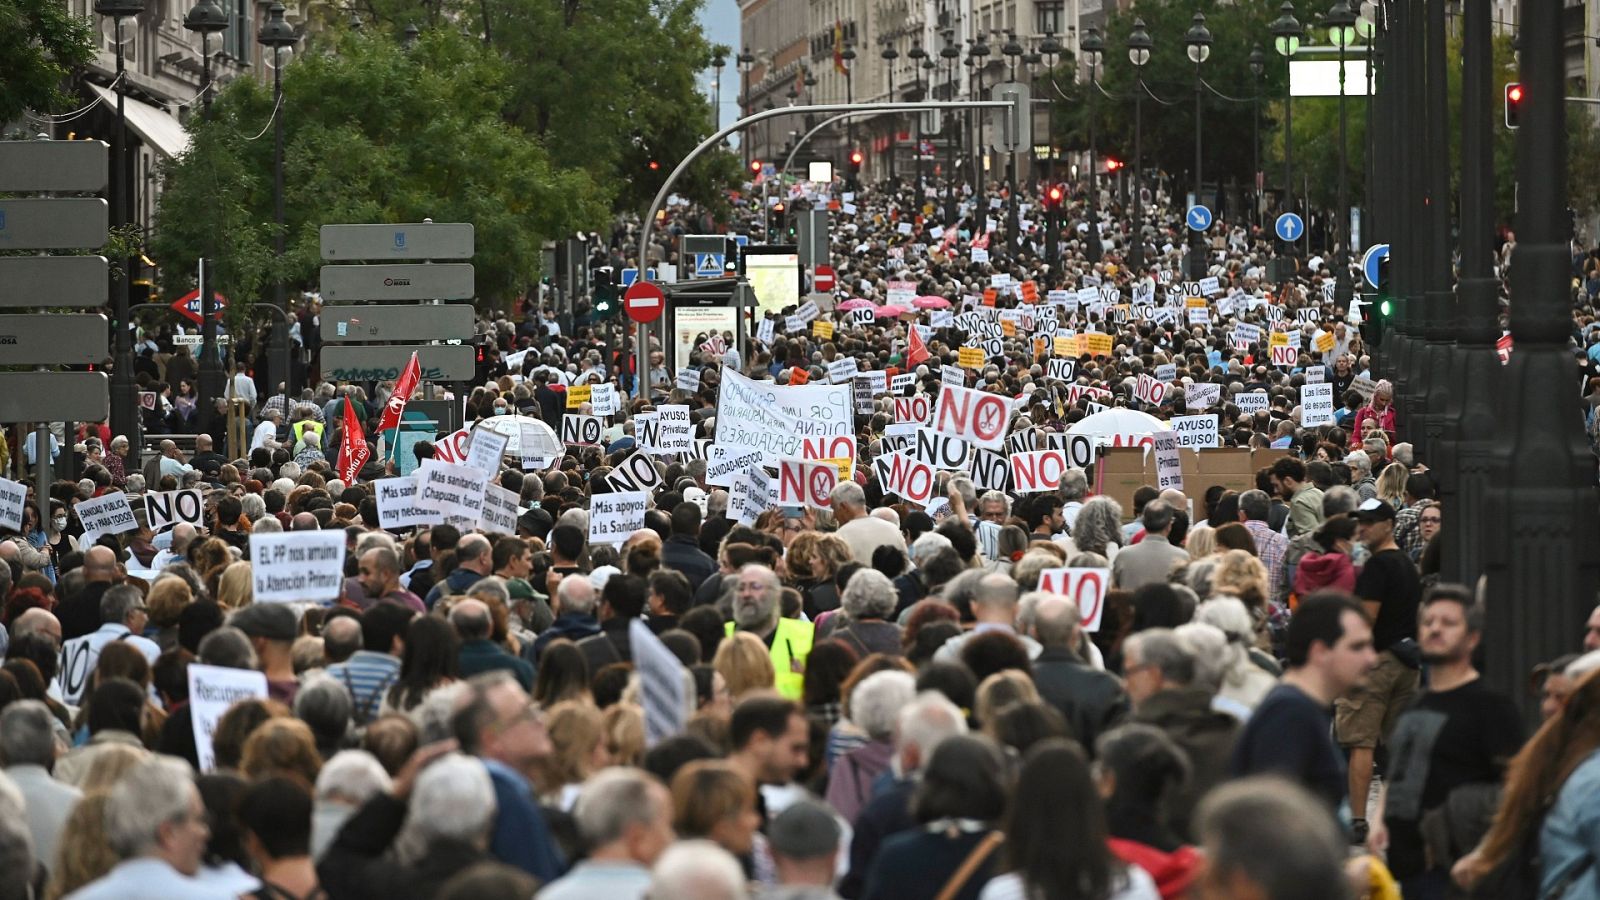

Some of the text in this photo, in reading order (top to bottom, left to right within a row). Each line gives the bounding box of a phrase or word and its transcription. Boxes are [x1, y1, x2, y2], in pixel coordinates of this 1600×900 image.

[1182, 283, 1200, 296] NO
[853, 310, 873, 322] NO
[1115, 308, 1126, 323] NO
[1267, 305, 1281, 321] NO
[1298, 309, 1319, 323] NO
[985, 323, 1002, 338] NO
[1040, 319, 1057, 333] NO
[981, 340, 1001, 356] NO
[1273, 347, 1296, 364] NO
[1049, 361, 1072, 379] NO
[1305, 387, 1330, 397] Las listas
[895, 398, 927, 422] NO
[938, 388, 1006, 440] NO
[1305, 401, 1331, 411] de espera
[660, 411, 688, 421] AYUSO:
[1173, 418, 1215, 431] ¡AYUSO,
[563, 416, 600, 444] NO
[434, 430, 470, 464] NO
[917, 429, 967, 467] NO
[1176, 433, 1215, 446] ABUSO!
[803, 437, 854, 465] NO
[1048, 435, 1091, 468] NO
[608, 453, 656, 492] NO
[708, 450, 763, 478] SANIDAD-NEGOCIO
[971, 448, 1007, 491] NO
[1013, 452, 1065, 490] NO
[447, 475, 484, 493] sanitarios!
[781, 460, 835, 506] NO
[889, 453, 932, 500] NO
[1161, 477, 1169, 485] es
[381, 485, 398, 502] ¡Más
[147, 490, 200, 527] NO
[383, 510, 399, 521] muy
[592, 501, 644, 515] ¡Más apoyos
[85, 522, 95, 530] DE
[98, 517, 112, 527] PARA
[592, 527, 597, 535] a
[600, 521, 607, 532] la
[274, 545, 285, 563] PP
[289, 548, 304, 560] nos
[1041, 571, 1101, 627] NO
[59, 641, 90, 695] NO
